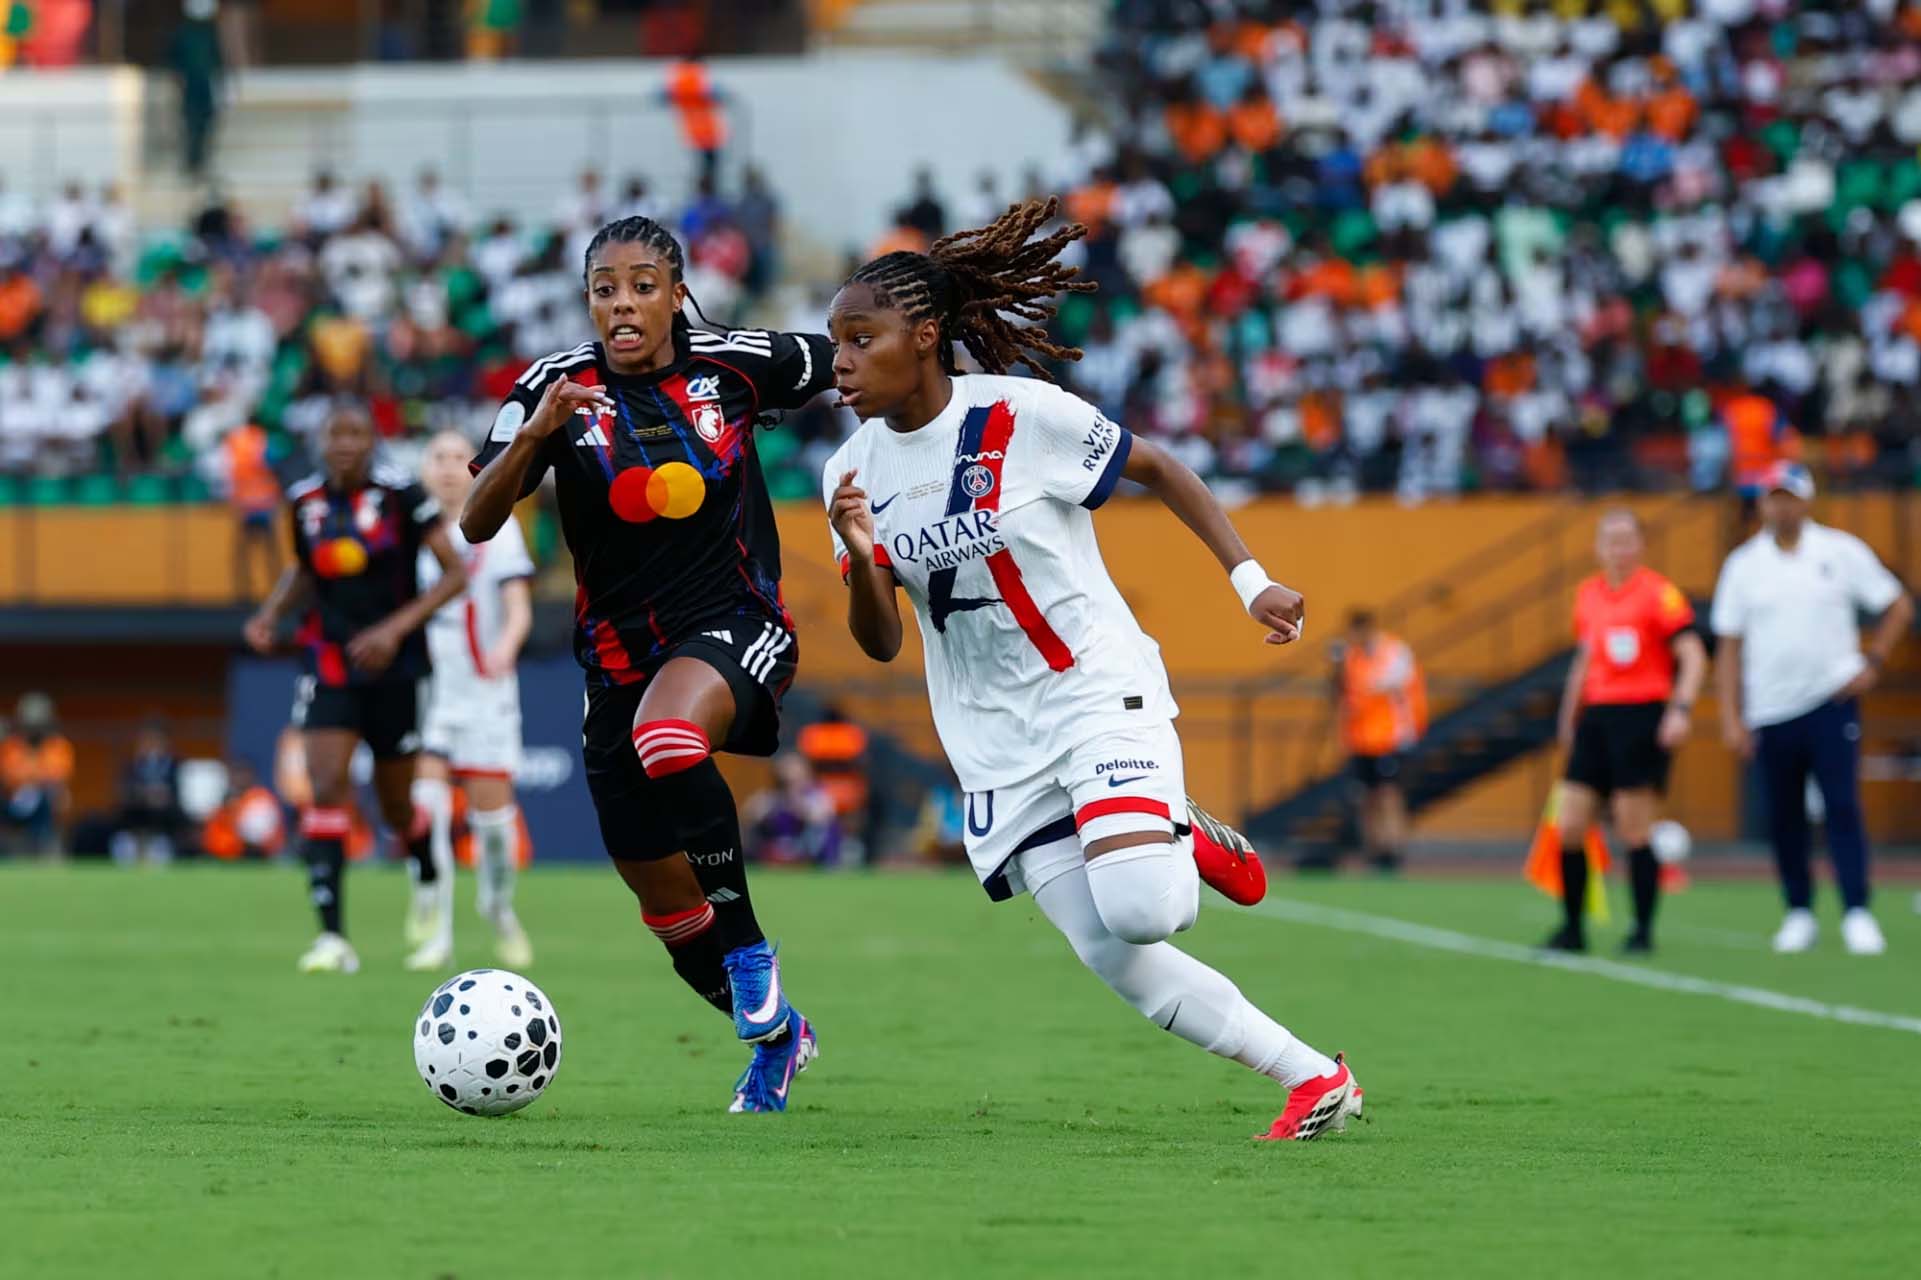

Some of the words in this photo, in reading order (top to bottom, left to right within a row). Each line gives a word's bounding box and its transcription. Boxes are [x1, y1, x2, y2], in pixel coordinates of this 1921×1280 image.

[1083, 408, 1105, 446] VISI
[1083, 427, 1114, 472] RWAN
[894, 510, 998, 563] QATAR
[925, 535, 1005, 571] AIRWAYS
[683, 848, 734, 865] LYON
